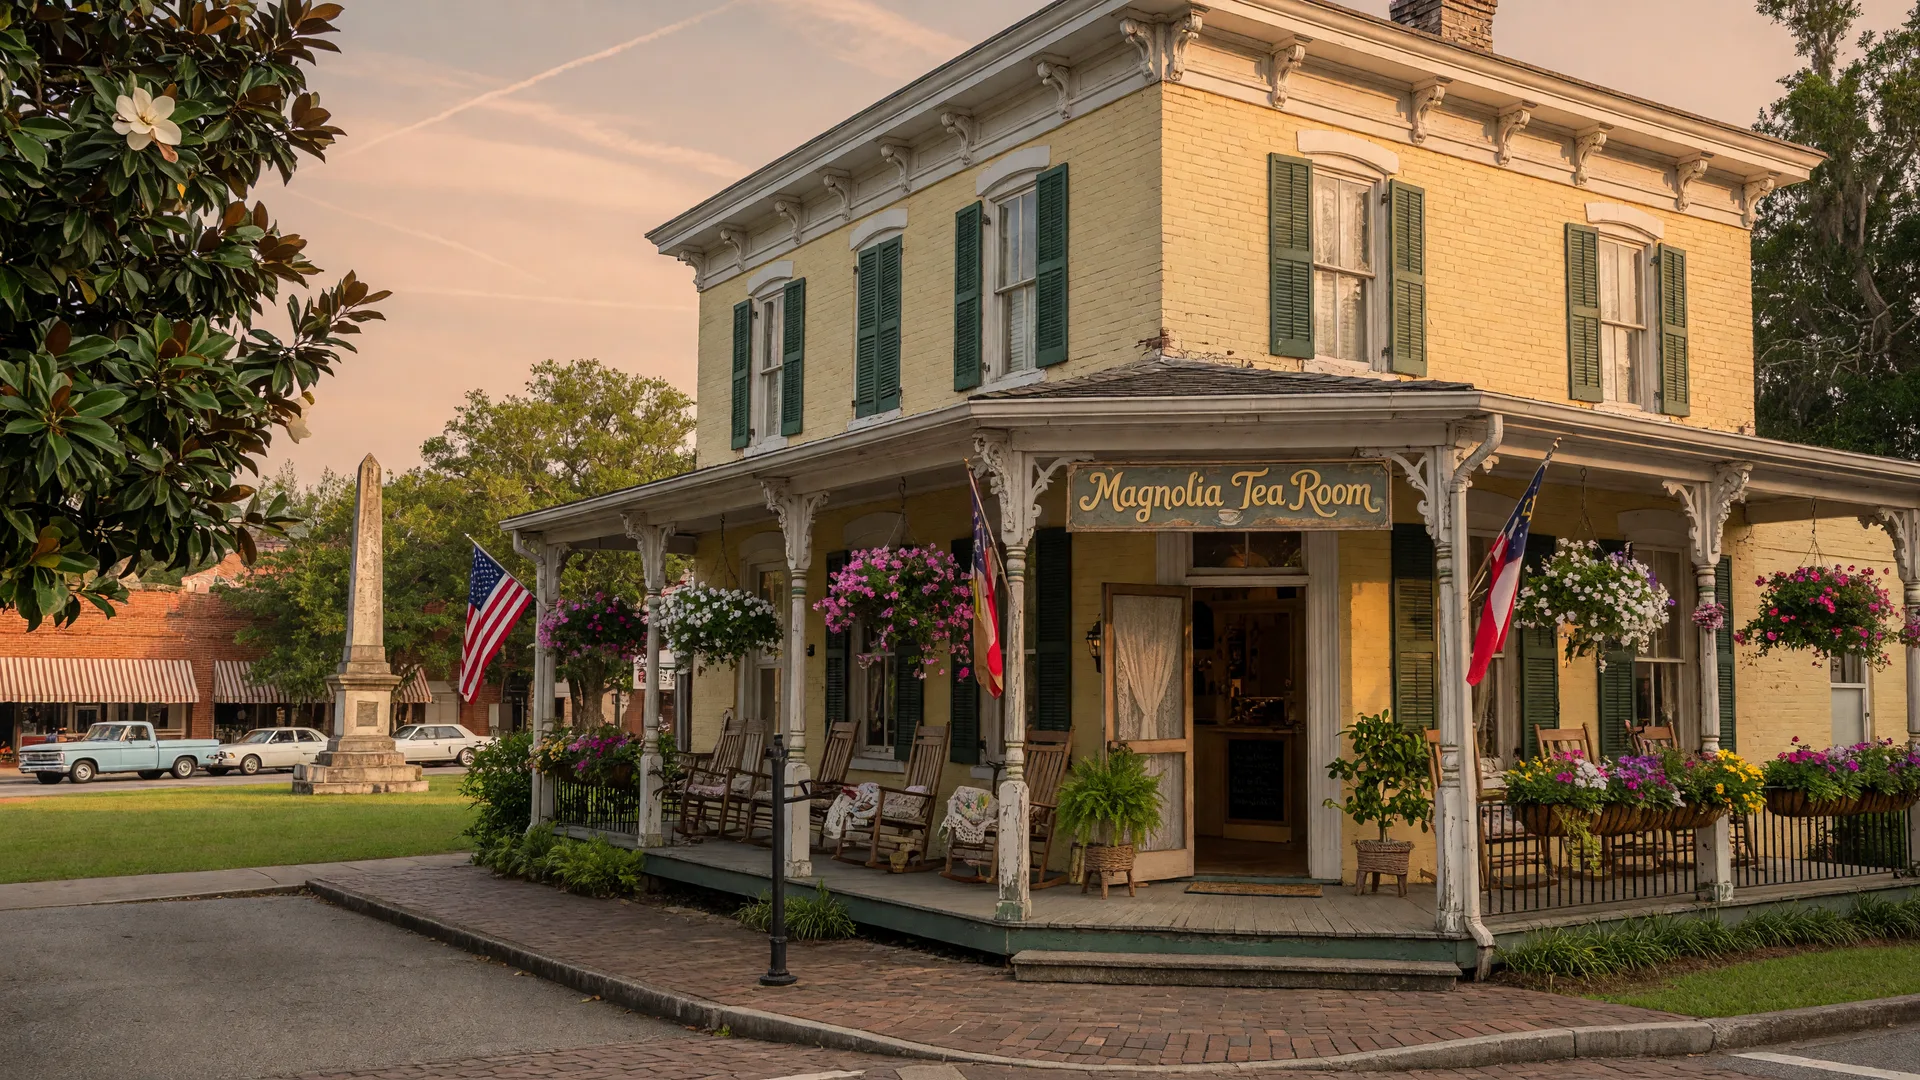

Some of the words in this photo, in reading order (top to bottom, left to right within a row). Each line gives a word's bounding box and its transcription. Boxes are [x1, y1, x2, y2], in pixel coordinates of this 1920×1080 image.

[1079, 471, 1225, 523] Magnolia
[1231, 467, 1286, 510] Tea
[1288, 468, 1381, 518] Room
